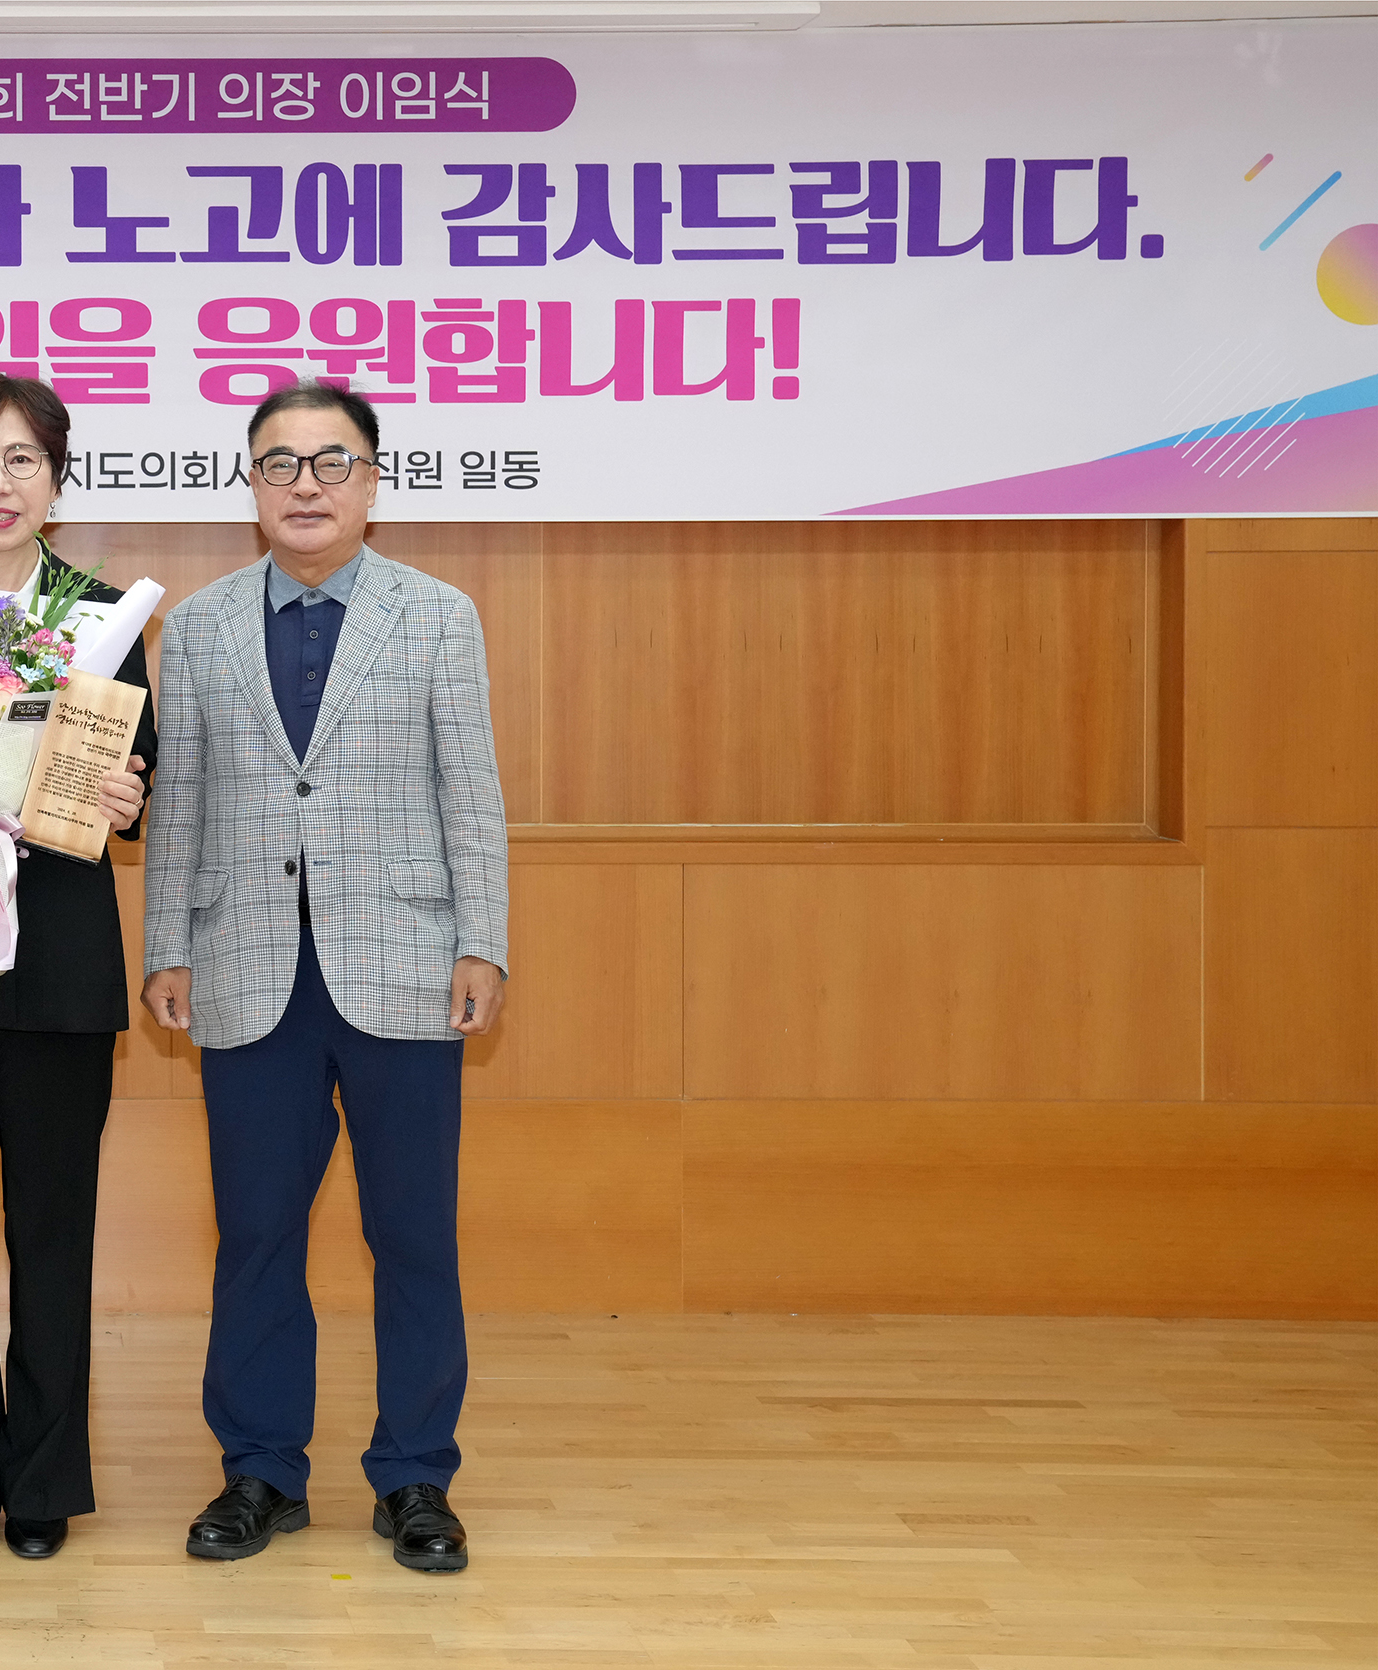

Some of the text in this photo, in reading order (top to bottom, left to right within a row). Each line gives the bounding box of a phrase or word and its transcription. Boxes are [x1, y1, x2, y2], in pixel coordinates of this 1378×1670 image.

[44, 71, 196, 122] 전반기
[216, 71, 321, 121] 의장
[339, 71, 490, 121] 이임식
[65, 161, 403, 267] 노고에
[440, 155, 1165, 267] 감사드립니다.
[192, 297, 802, 405] 응원합니다!
[460, 450, 541, 490] 일동
